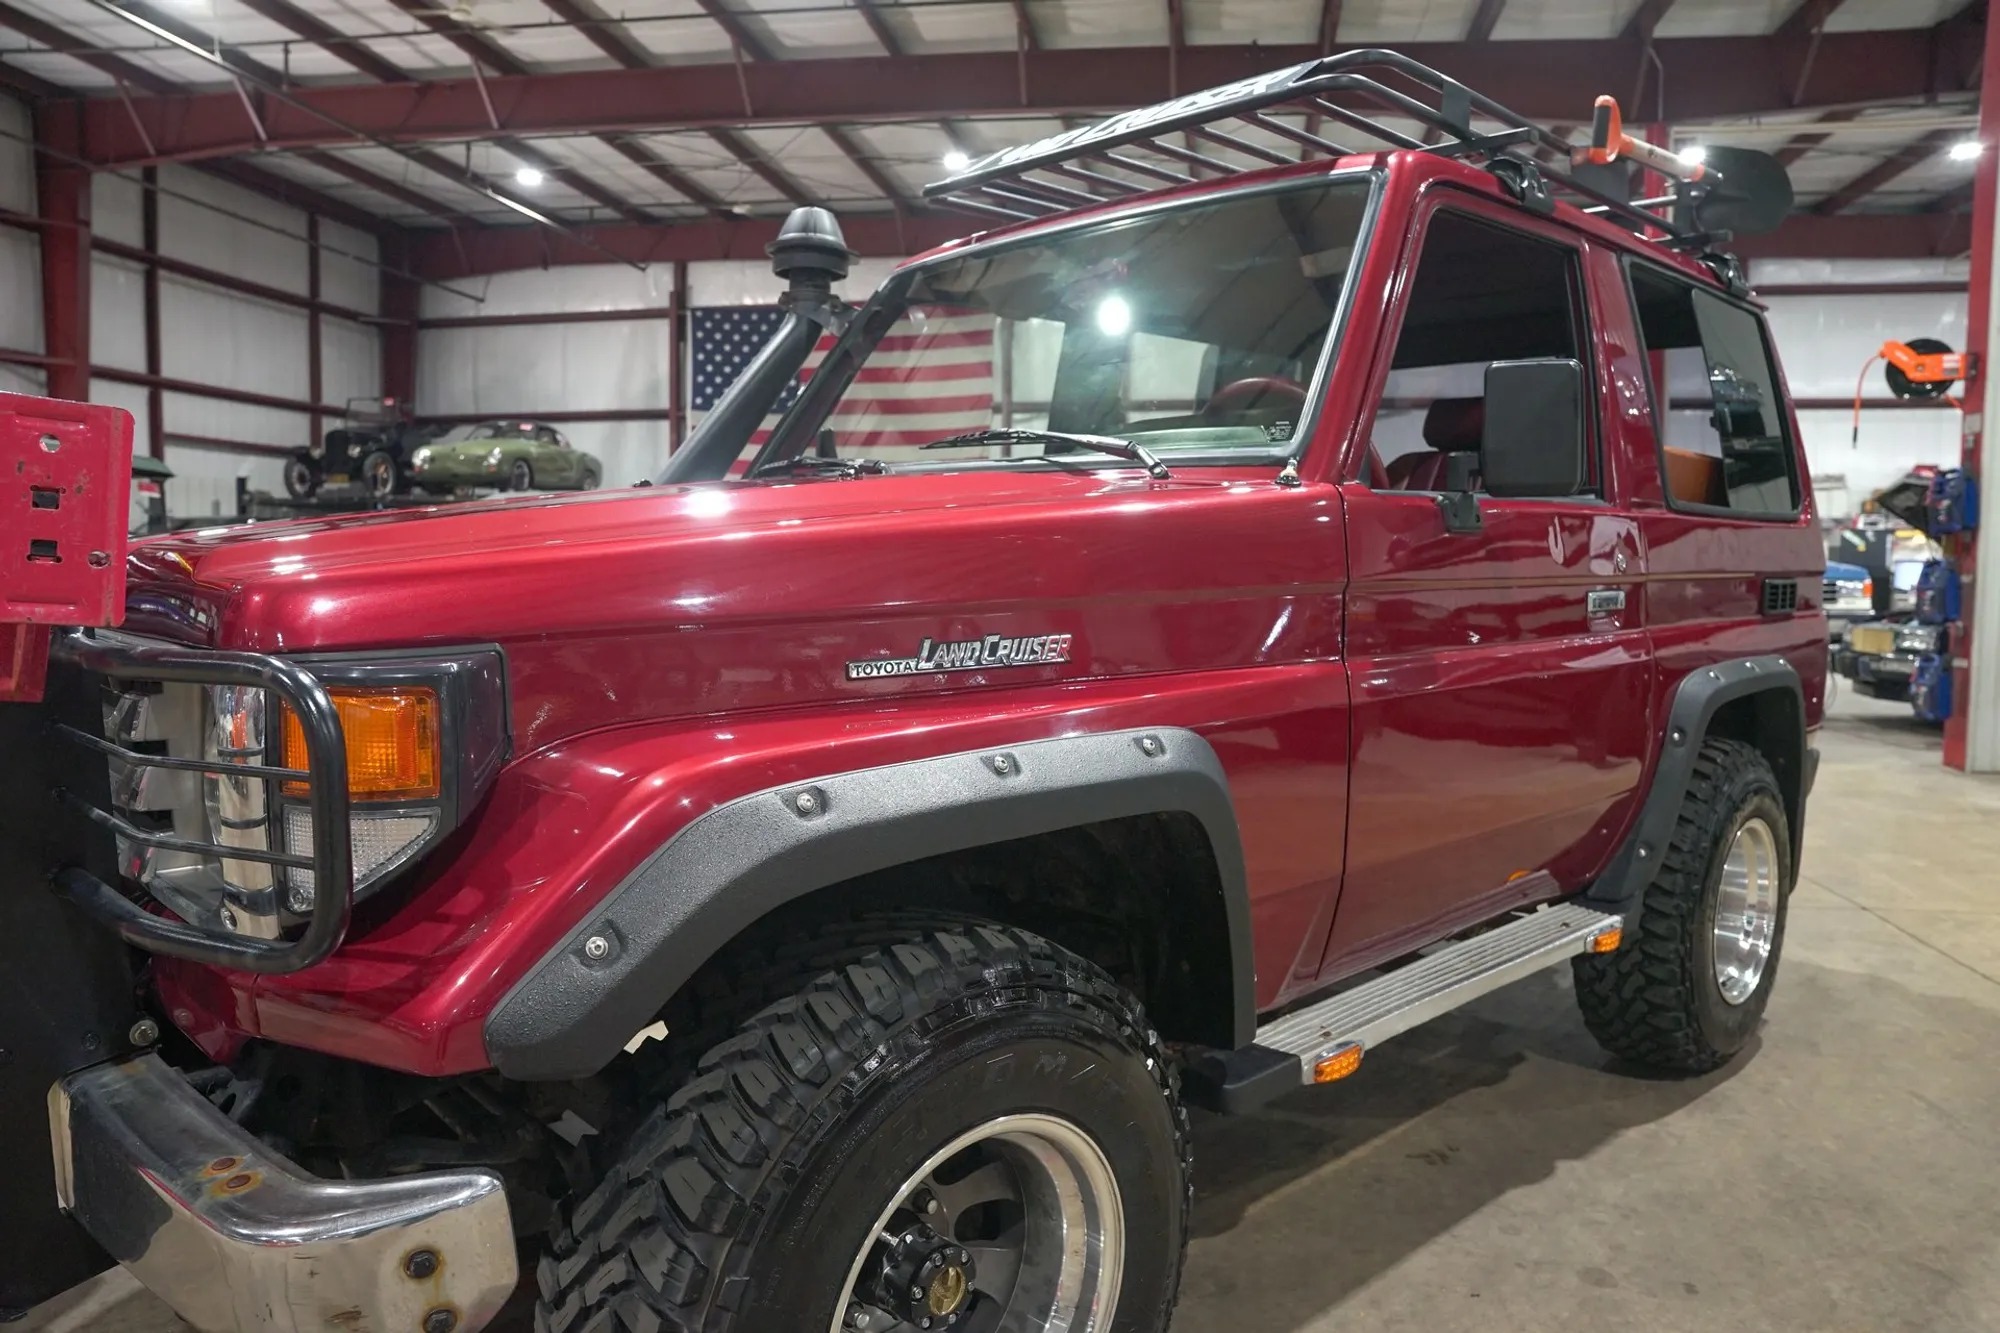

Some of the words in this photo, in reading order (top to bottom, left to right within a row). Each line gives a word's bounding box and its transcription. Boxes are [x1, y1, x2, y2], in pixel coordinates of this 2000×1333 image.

[853, 661, 914, 677] TOYOTA
[916, 638, 983, 670] LAND
[983, 634, 1073, 666] CRUISER
